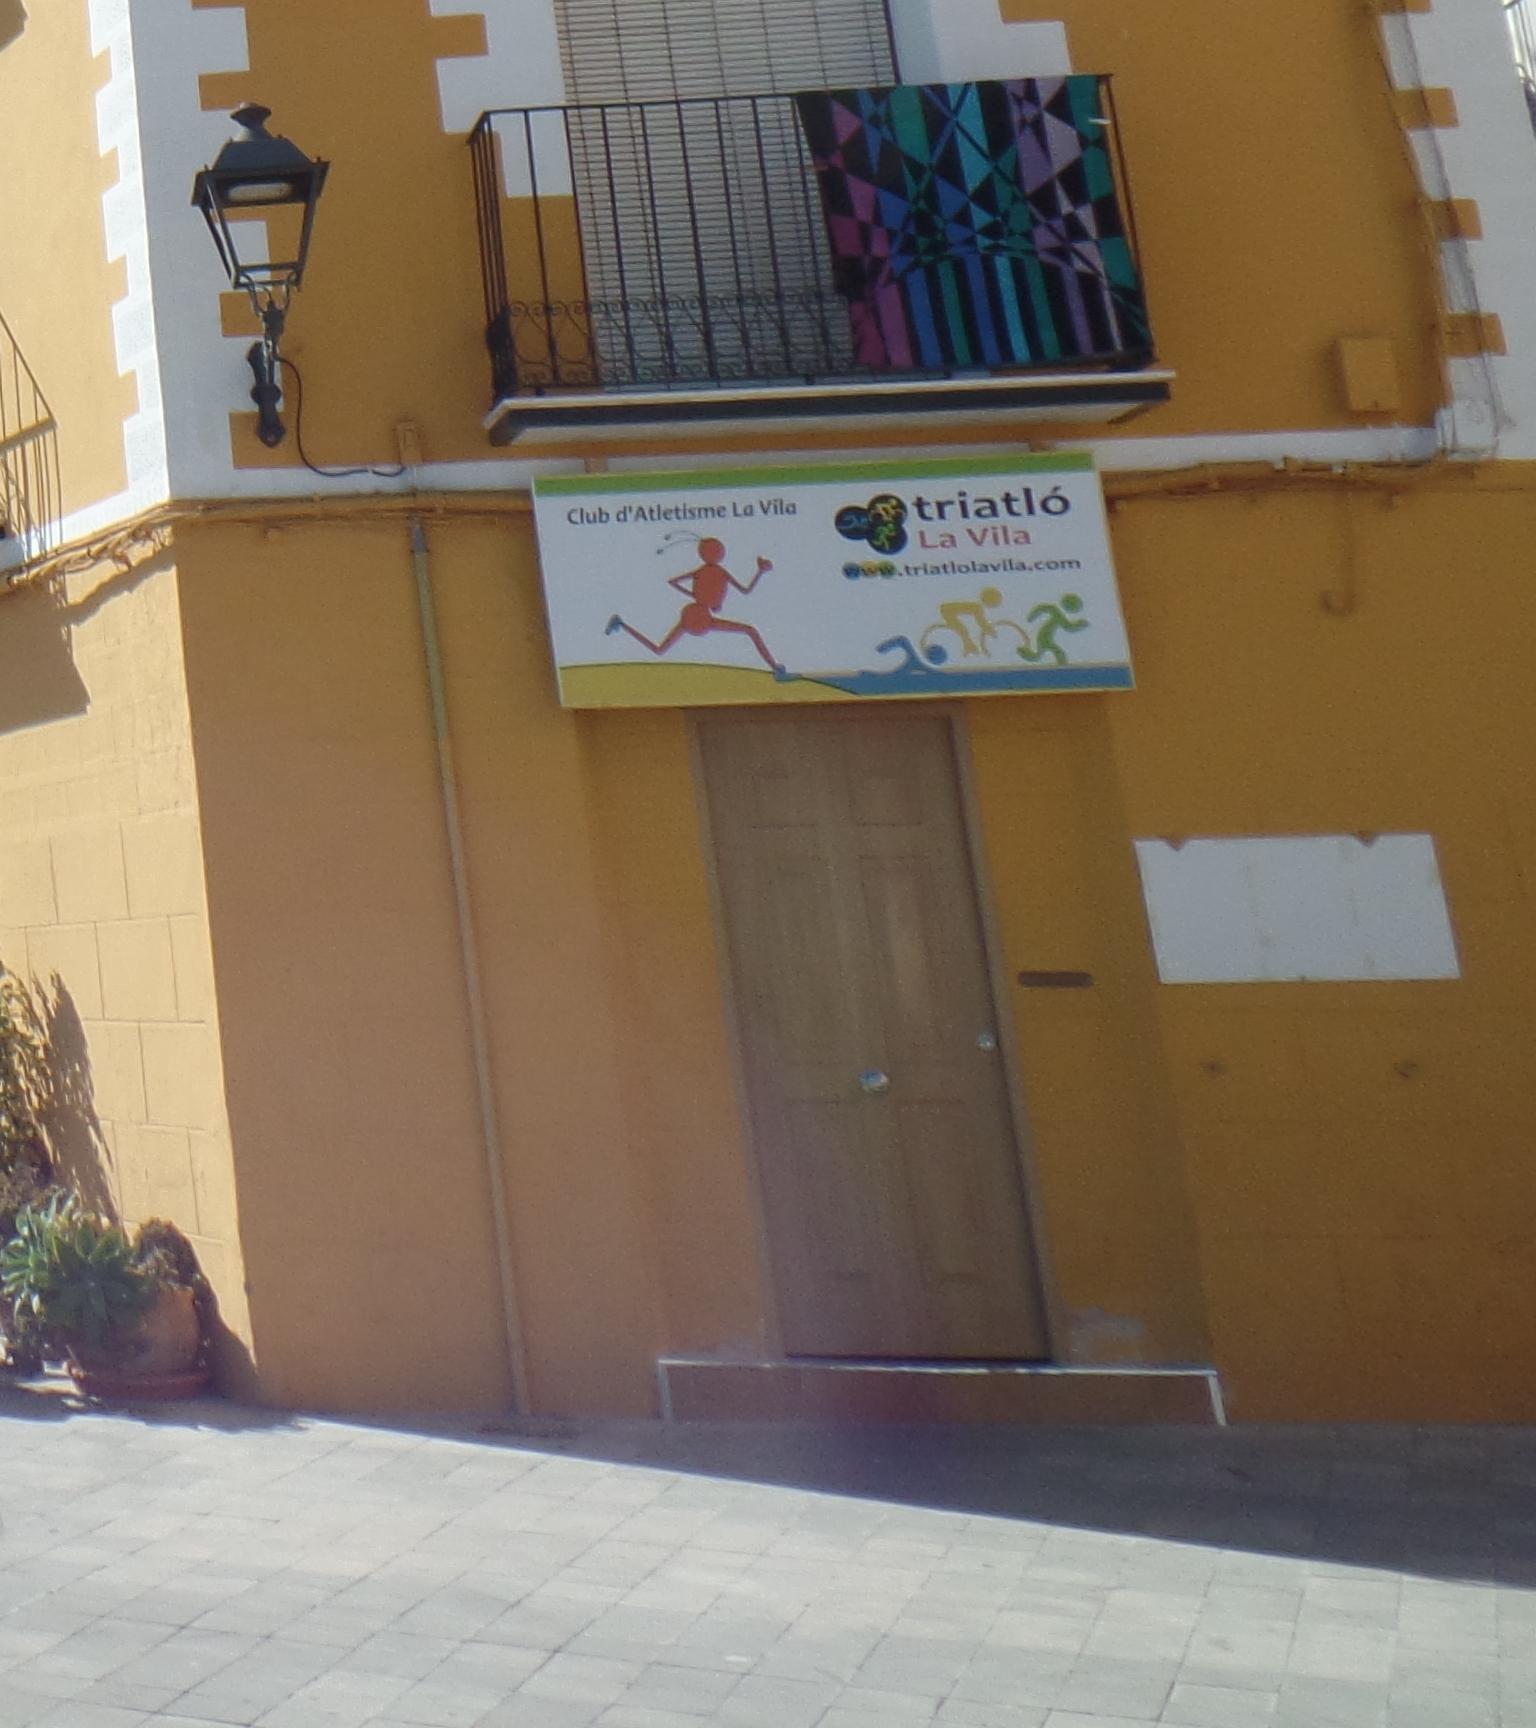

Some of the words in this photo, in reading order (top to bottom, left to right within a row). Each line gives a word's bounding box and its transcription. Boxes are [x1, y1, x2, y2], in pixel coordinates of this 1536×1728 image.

[567, 506, 610, 525] Club
[616, 502, 728, 523] d'Atletisme
[732, 502, 755, 518] La
[759, 498, 797, 516] Vila
[912, 485, 1071, 522] triatló
[918, 528, 958, 550] La
[966, 524, 1032, 548] Vila
[843, 557, 1082, 579] www.triatlolavila.com
